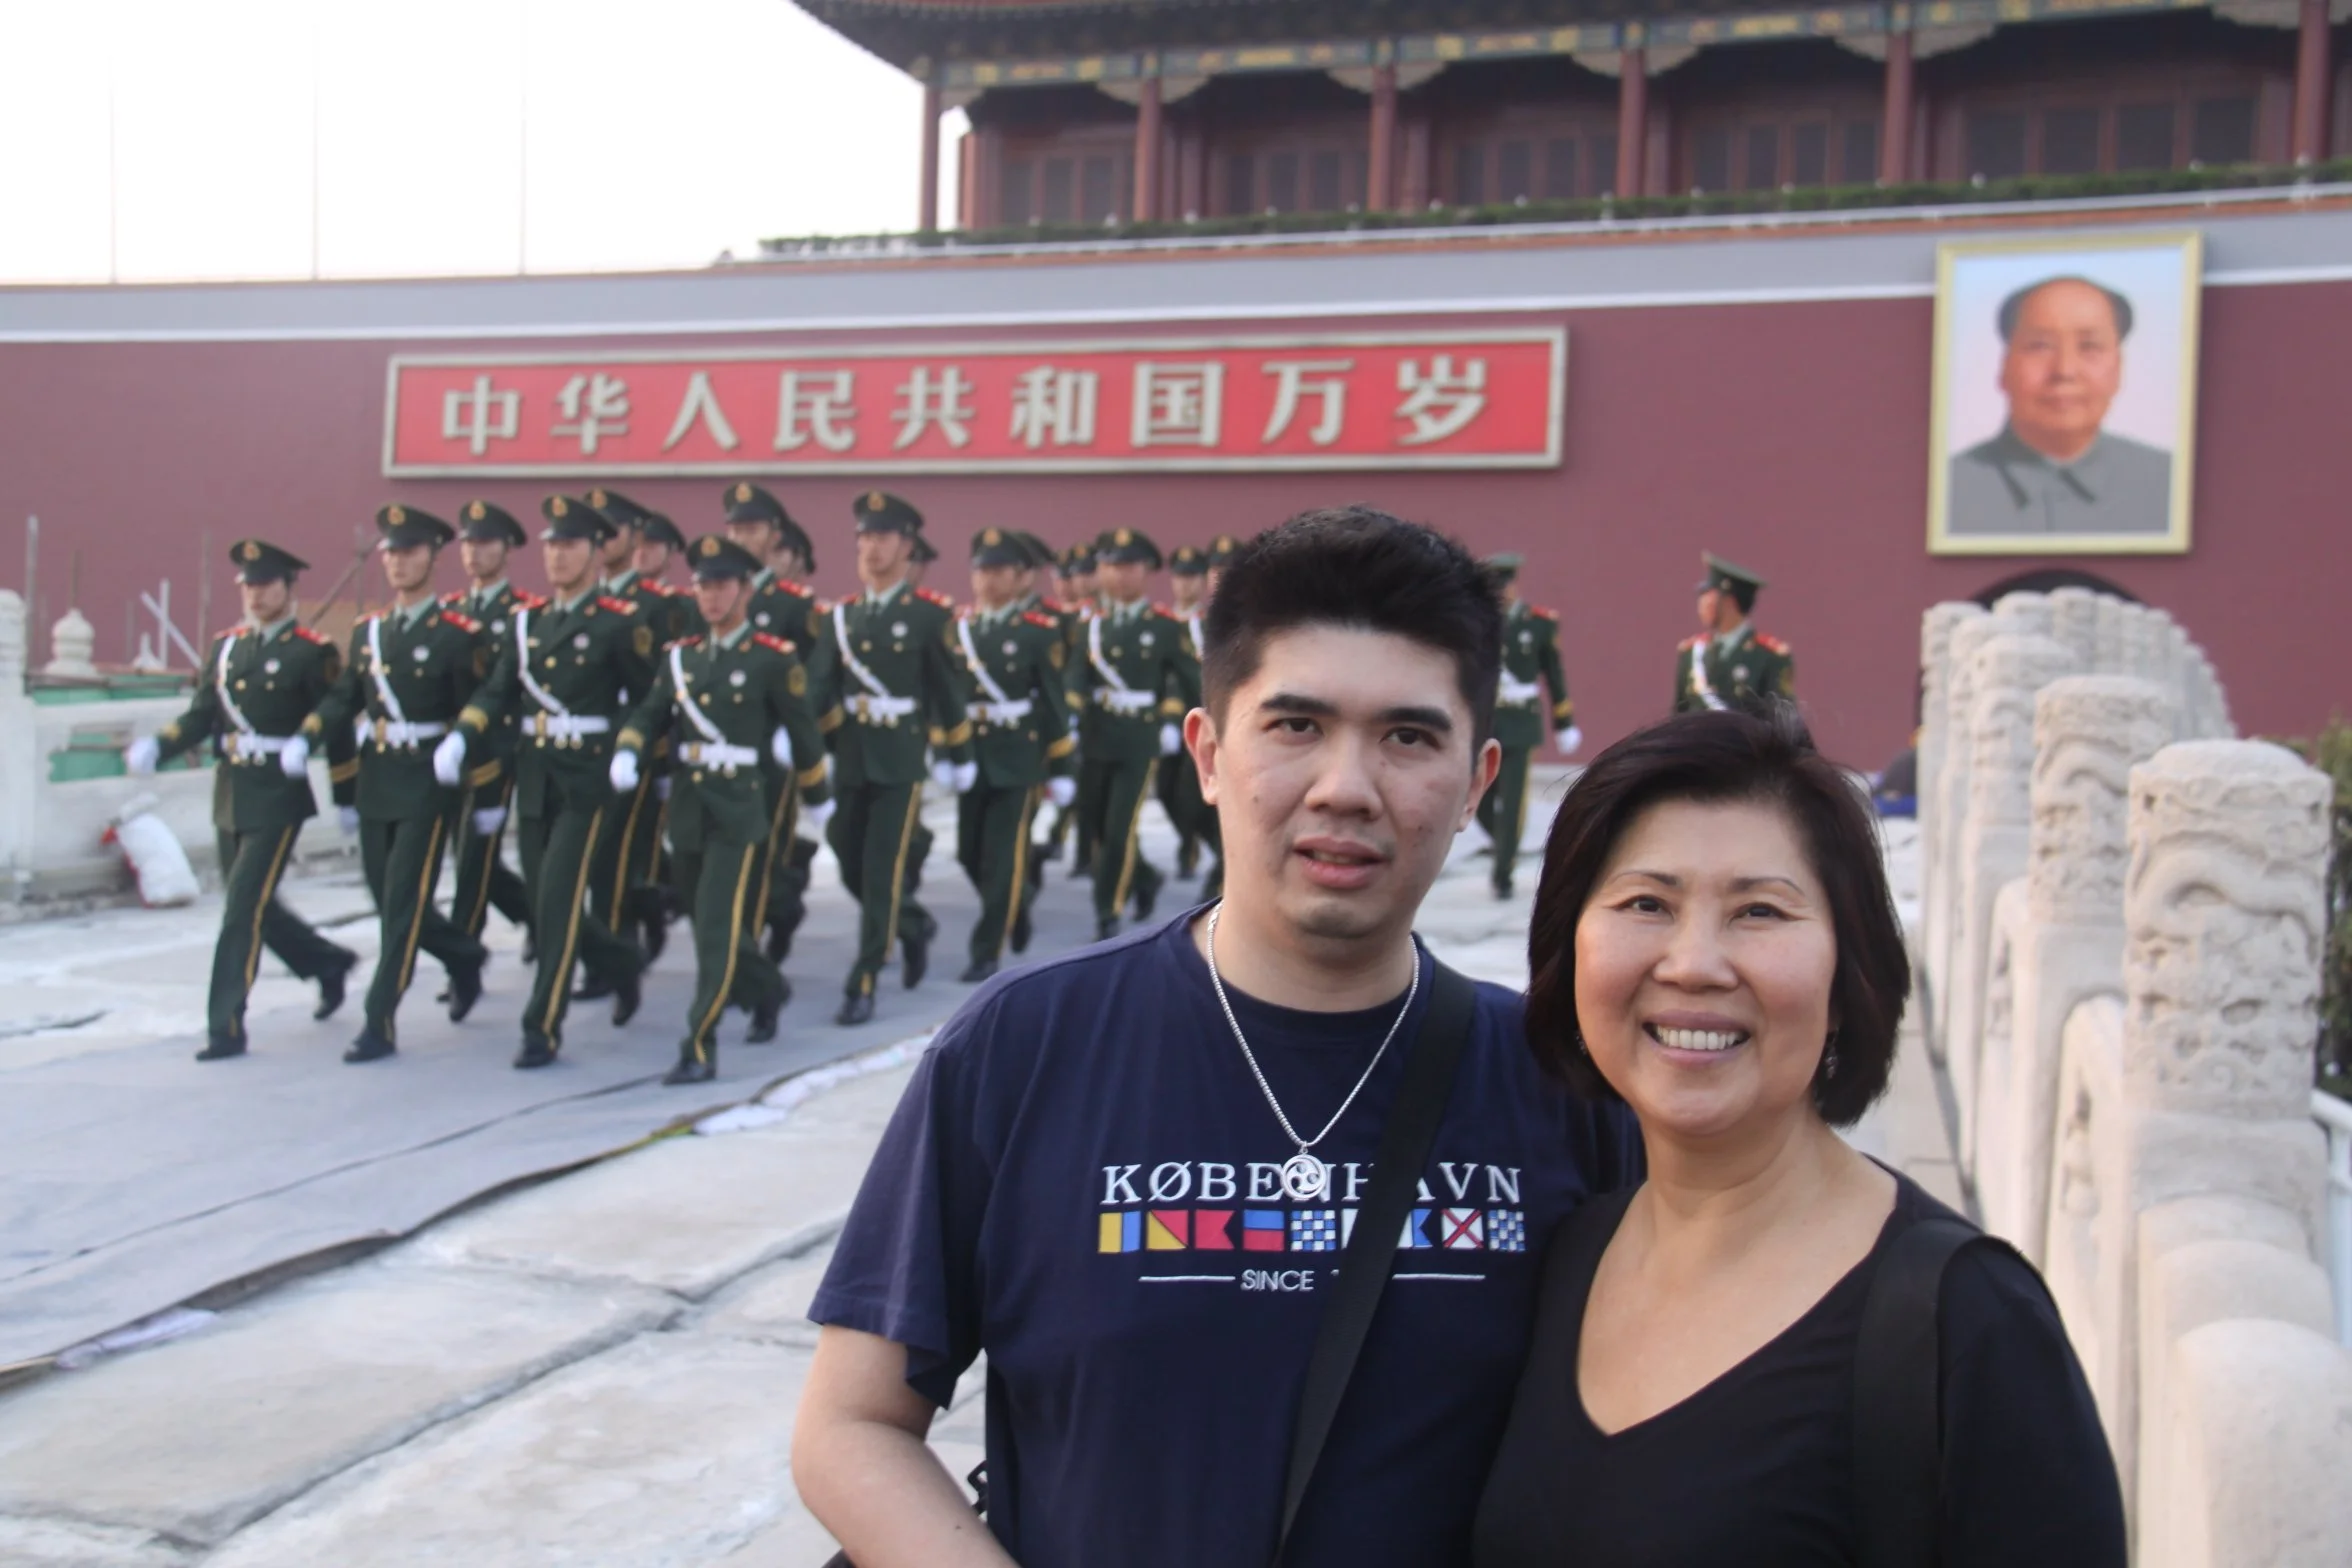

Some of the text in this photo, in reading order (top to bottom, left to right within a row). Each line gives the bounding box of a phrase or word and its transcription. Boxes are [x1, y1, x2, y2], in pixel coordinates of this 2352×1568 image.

[441, 355, 1487, 456] 中华人民共和国万岁
[1240, 1268, 1315, 1292] SINCE
